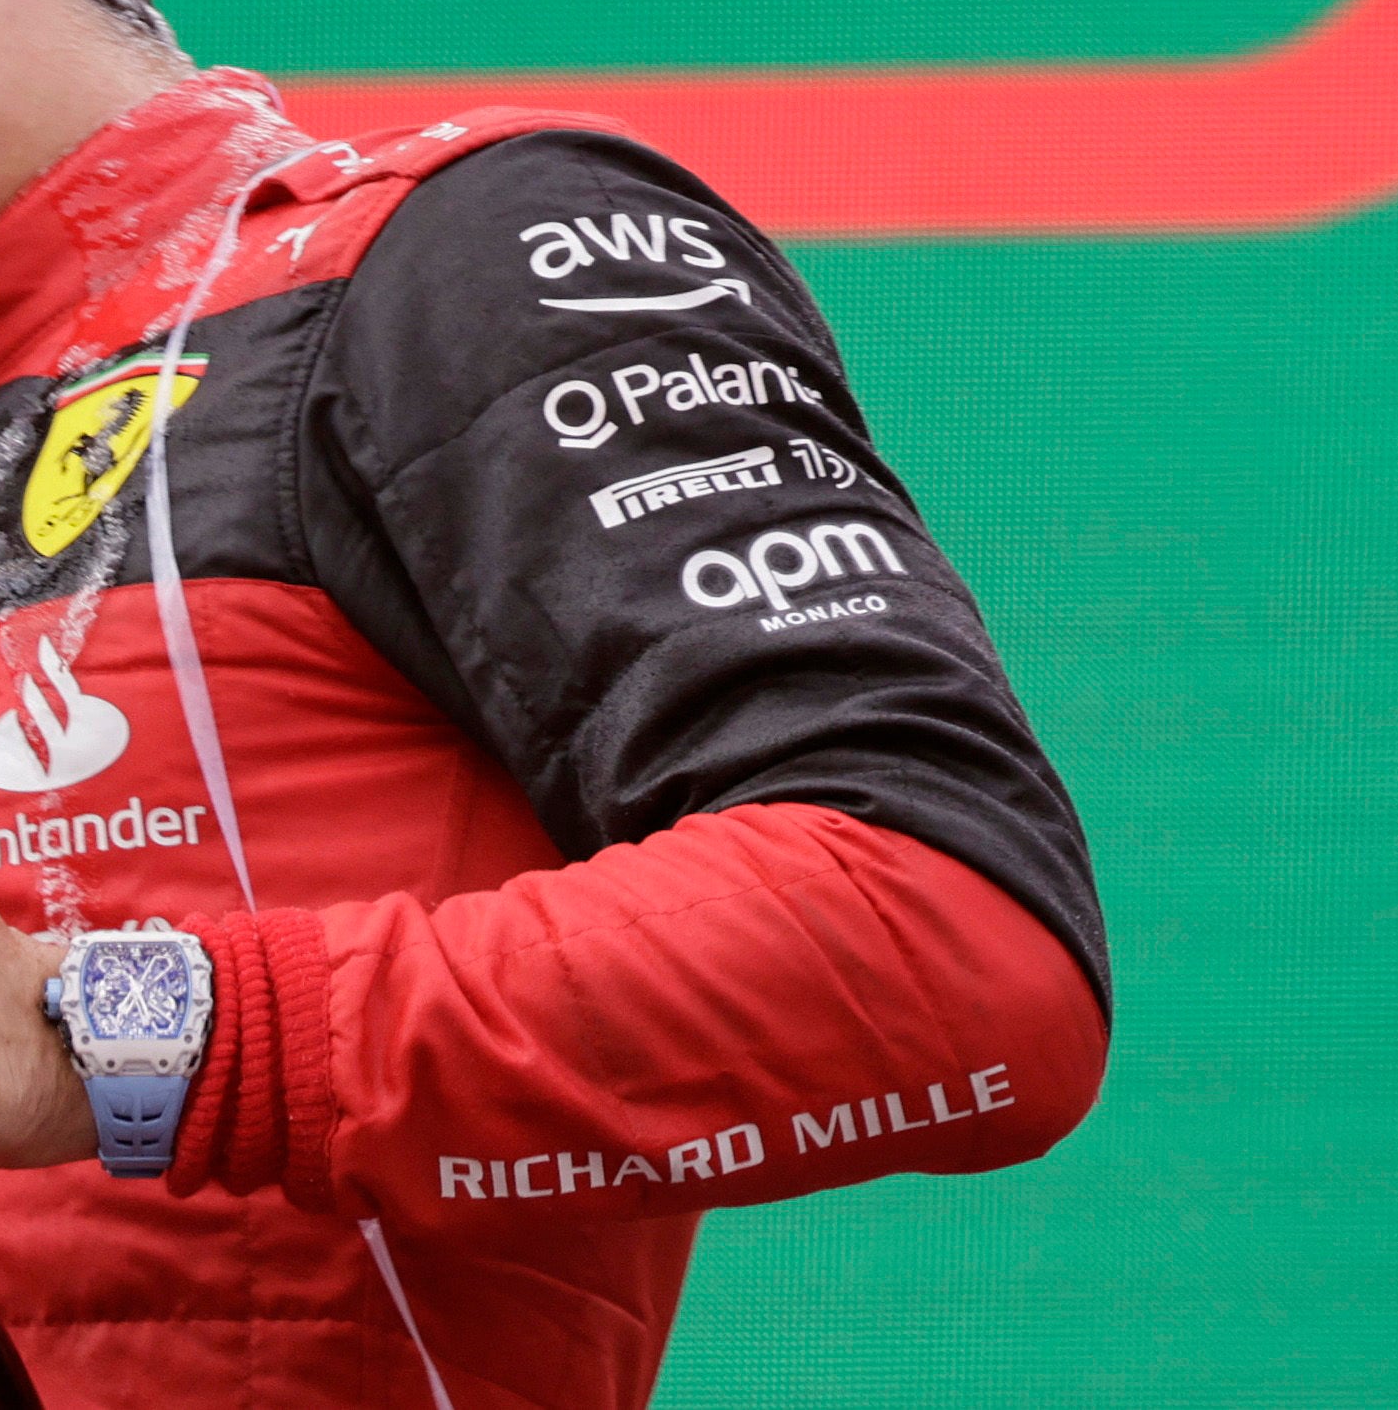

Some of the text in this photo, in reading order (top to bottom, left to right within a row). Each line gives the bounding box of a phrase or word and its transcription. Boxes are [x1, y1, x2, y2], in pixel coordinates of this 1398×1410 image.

[519, 213, 727, 280] aws
[588, 445, 783, 529] PIRELLI
[681, 522, 909, 611] apm
[760, 595, 888, 633] MONACO
[438, 1063, 1016, 1200] RICHARD MILLE
